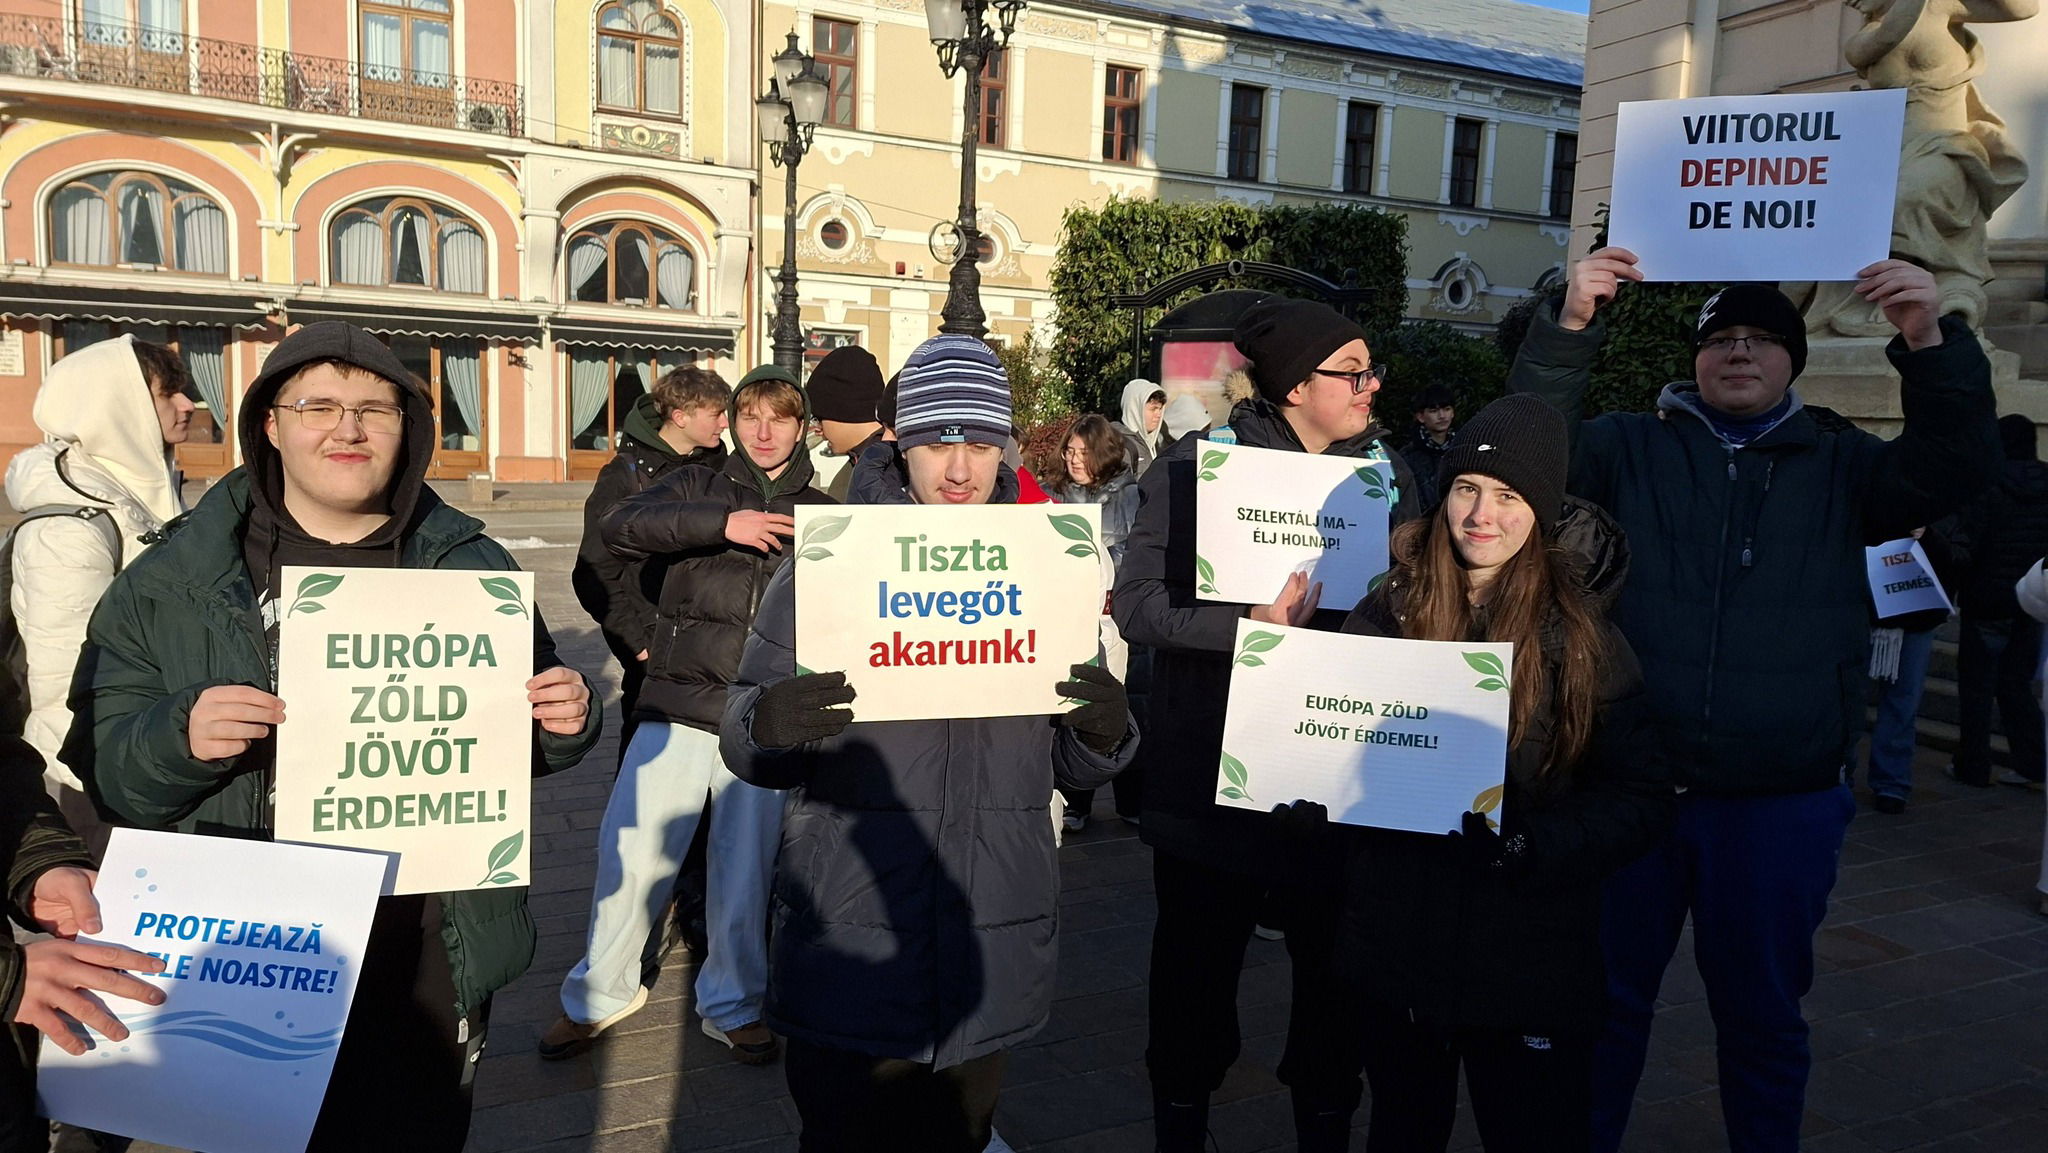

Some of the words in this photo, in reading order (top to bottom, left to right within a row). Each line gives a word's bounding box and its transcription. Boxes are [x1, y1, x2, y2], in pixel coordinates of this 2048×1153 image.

[1683, 111, 1841, 145] VIITORUL
[1681, 156, 1829, 187] DEPINDE
[1689, 201, 1732, 229] DE
[1743, 200, 1816, 229] NOI!
[1237, 507, 1320, 528] SZELEKTÁLJ
[1324, 516, 1346, 530] MA
[894, 534, 1008, 572] Tiszta
[1253, 527, 1277, 544] ÉLJ
[1282, 533, 1341, 550] HOLNAP!
[1881, 551, 1917, 567] TISZ
[879, 581, 1023, 625] levegőt
[1883, 576, 1935, 595] TERMÉS
[326, 623, 498, 669] EURÓPA
[869, 629, 1036, 668] akarunk!
[350, 674, 468, 724] ZŐLD
[1305, 695, 1375, 716] EURÓPA
[1381, 701, 1428, 721] ZÖLD
[1294, 719, 1350, 741] JÖVŐT
[1354, 725, 1439, 750] ÉRDEMEL!
[338, 727, 478, 780] JÖVŐT
[313, 786, 507, 832] ÉRDEMEL!
[134, 912, 324, 955] PROTEJEAZĂ
[199, 957, 338, 994] NOASTRE!
